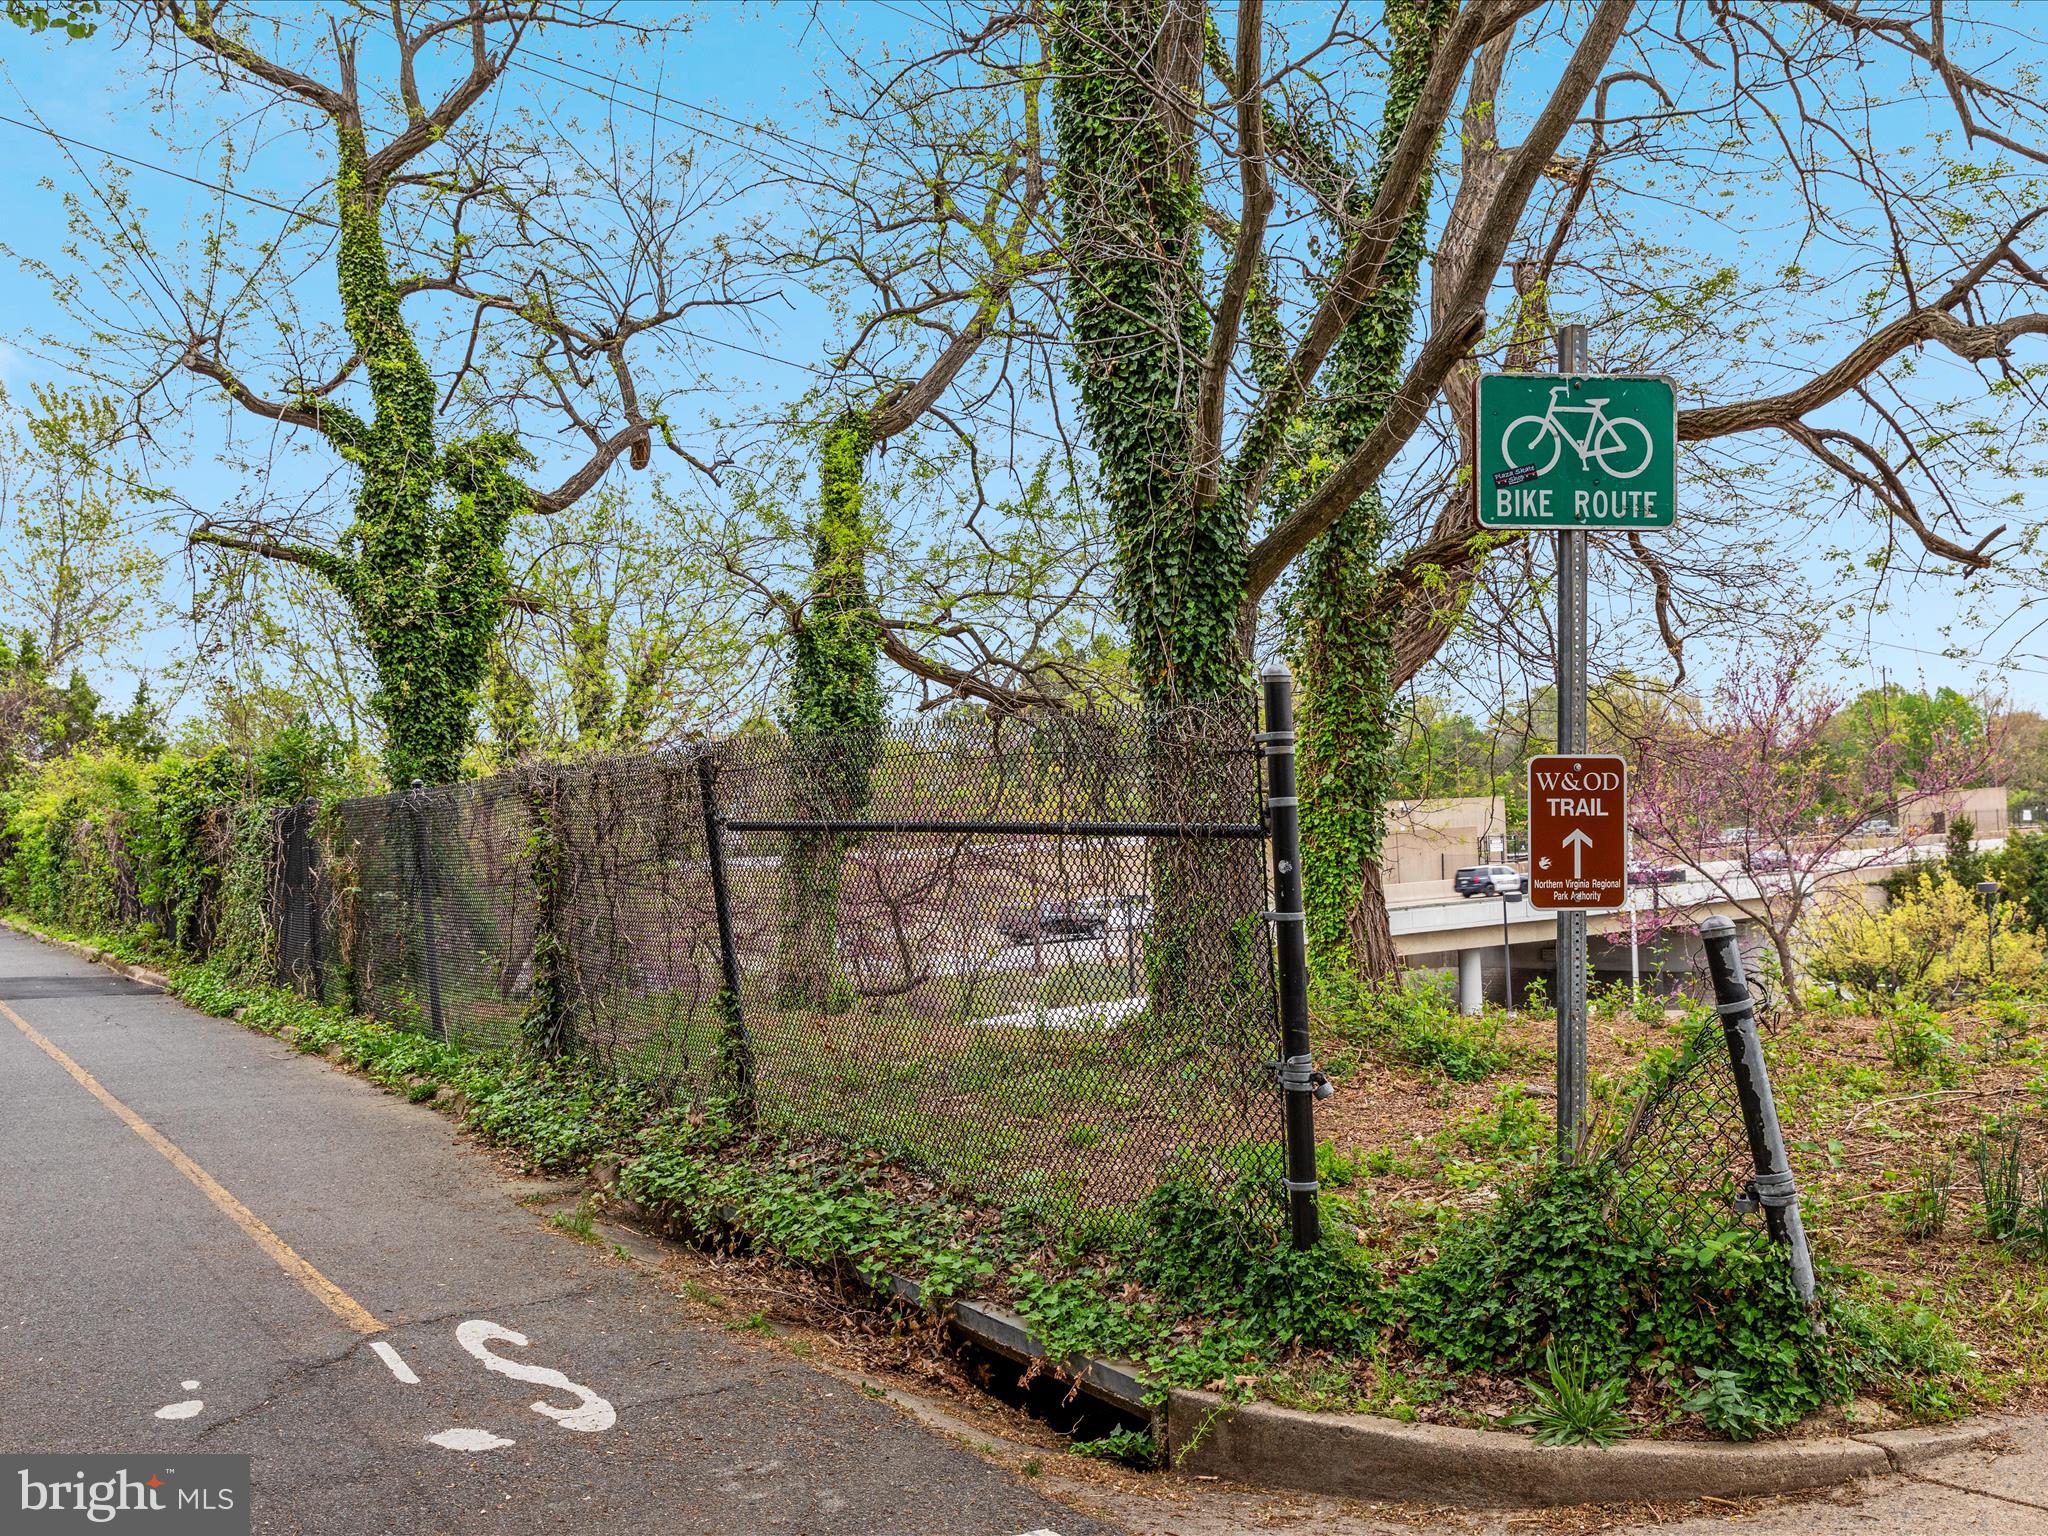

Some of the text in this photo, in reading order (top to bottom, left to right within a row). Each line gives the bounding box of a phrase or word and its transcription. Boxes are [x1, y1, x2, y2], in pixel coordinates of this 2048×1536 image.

[1496, 489, 1658, 518] BIKE ROUTE
[1536, 772, 1620, 791] W&OD
[1546, 798, 1608, 817] TRAIL
[1534, 879, 1563, 889] Northern
[1565, 879, 1590, 890] Virginia
[1592, 879, 1621, 890] Regional
[1553, 891, 1601, 902] Park Athority
